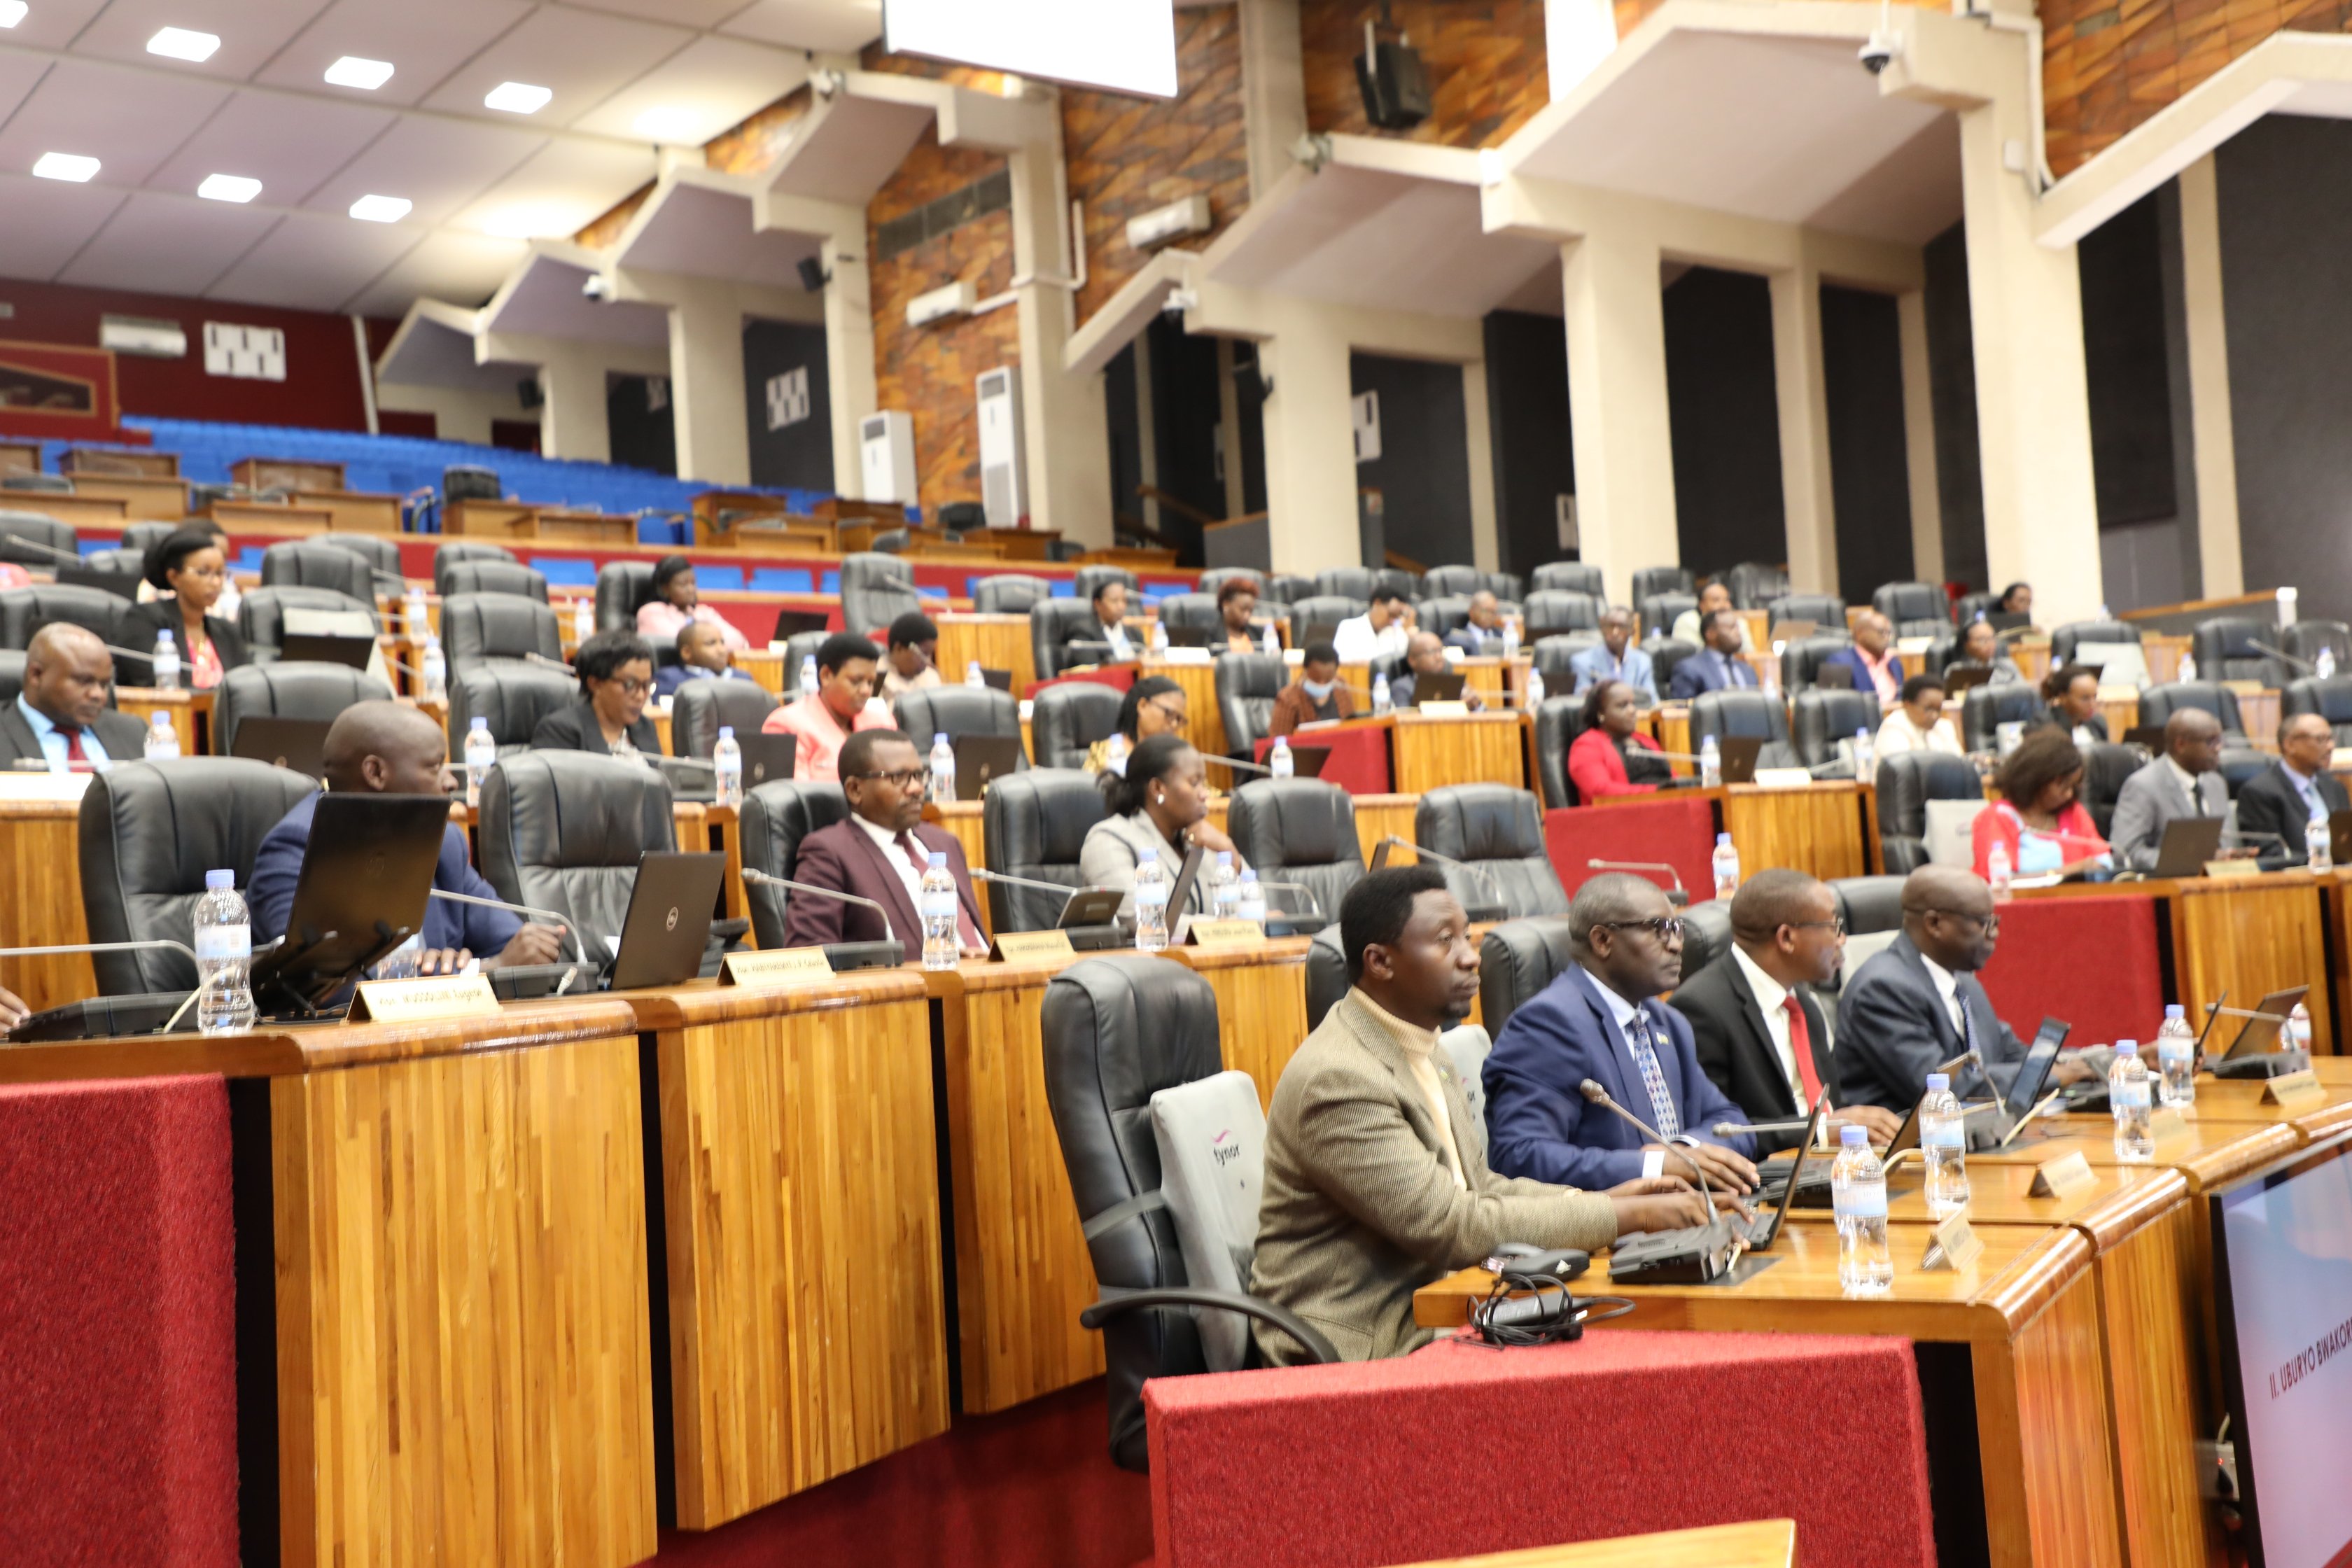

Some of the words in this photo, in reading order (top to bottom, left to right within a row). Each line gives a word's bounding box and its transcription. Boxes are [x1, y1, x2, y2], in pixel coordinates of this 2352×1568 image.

[1213, 1144, 1240, 1168] tynor
[2269, 1371, 2280, 1400] II.
[2280, 1345, 2316, 1392] UBURYO
